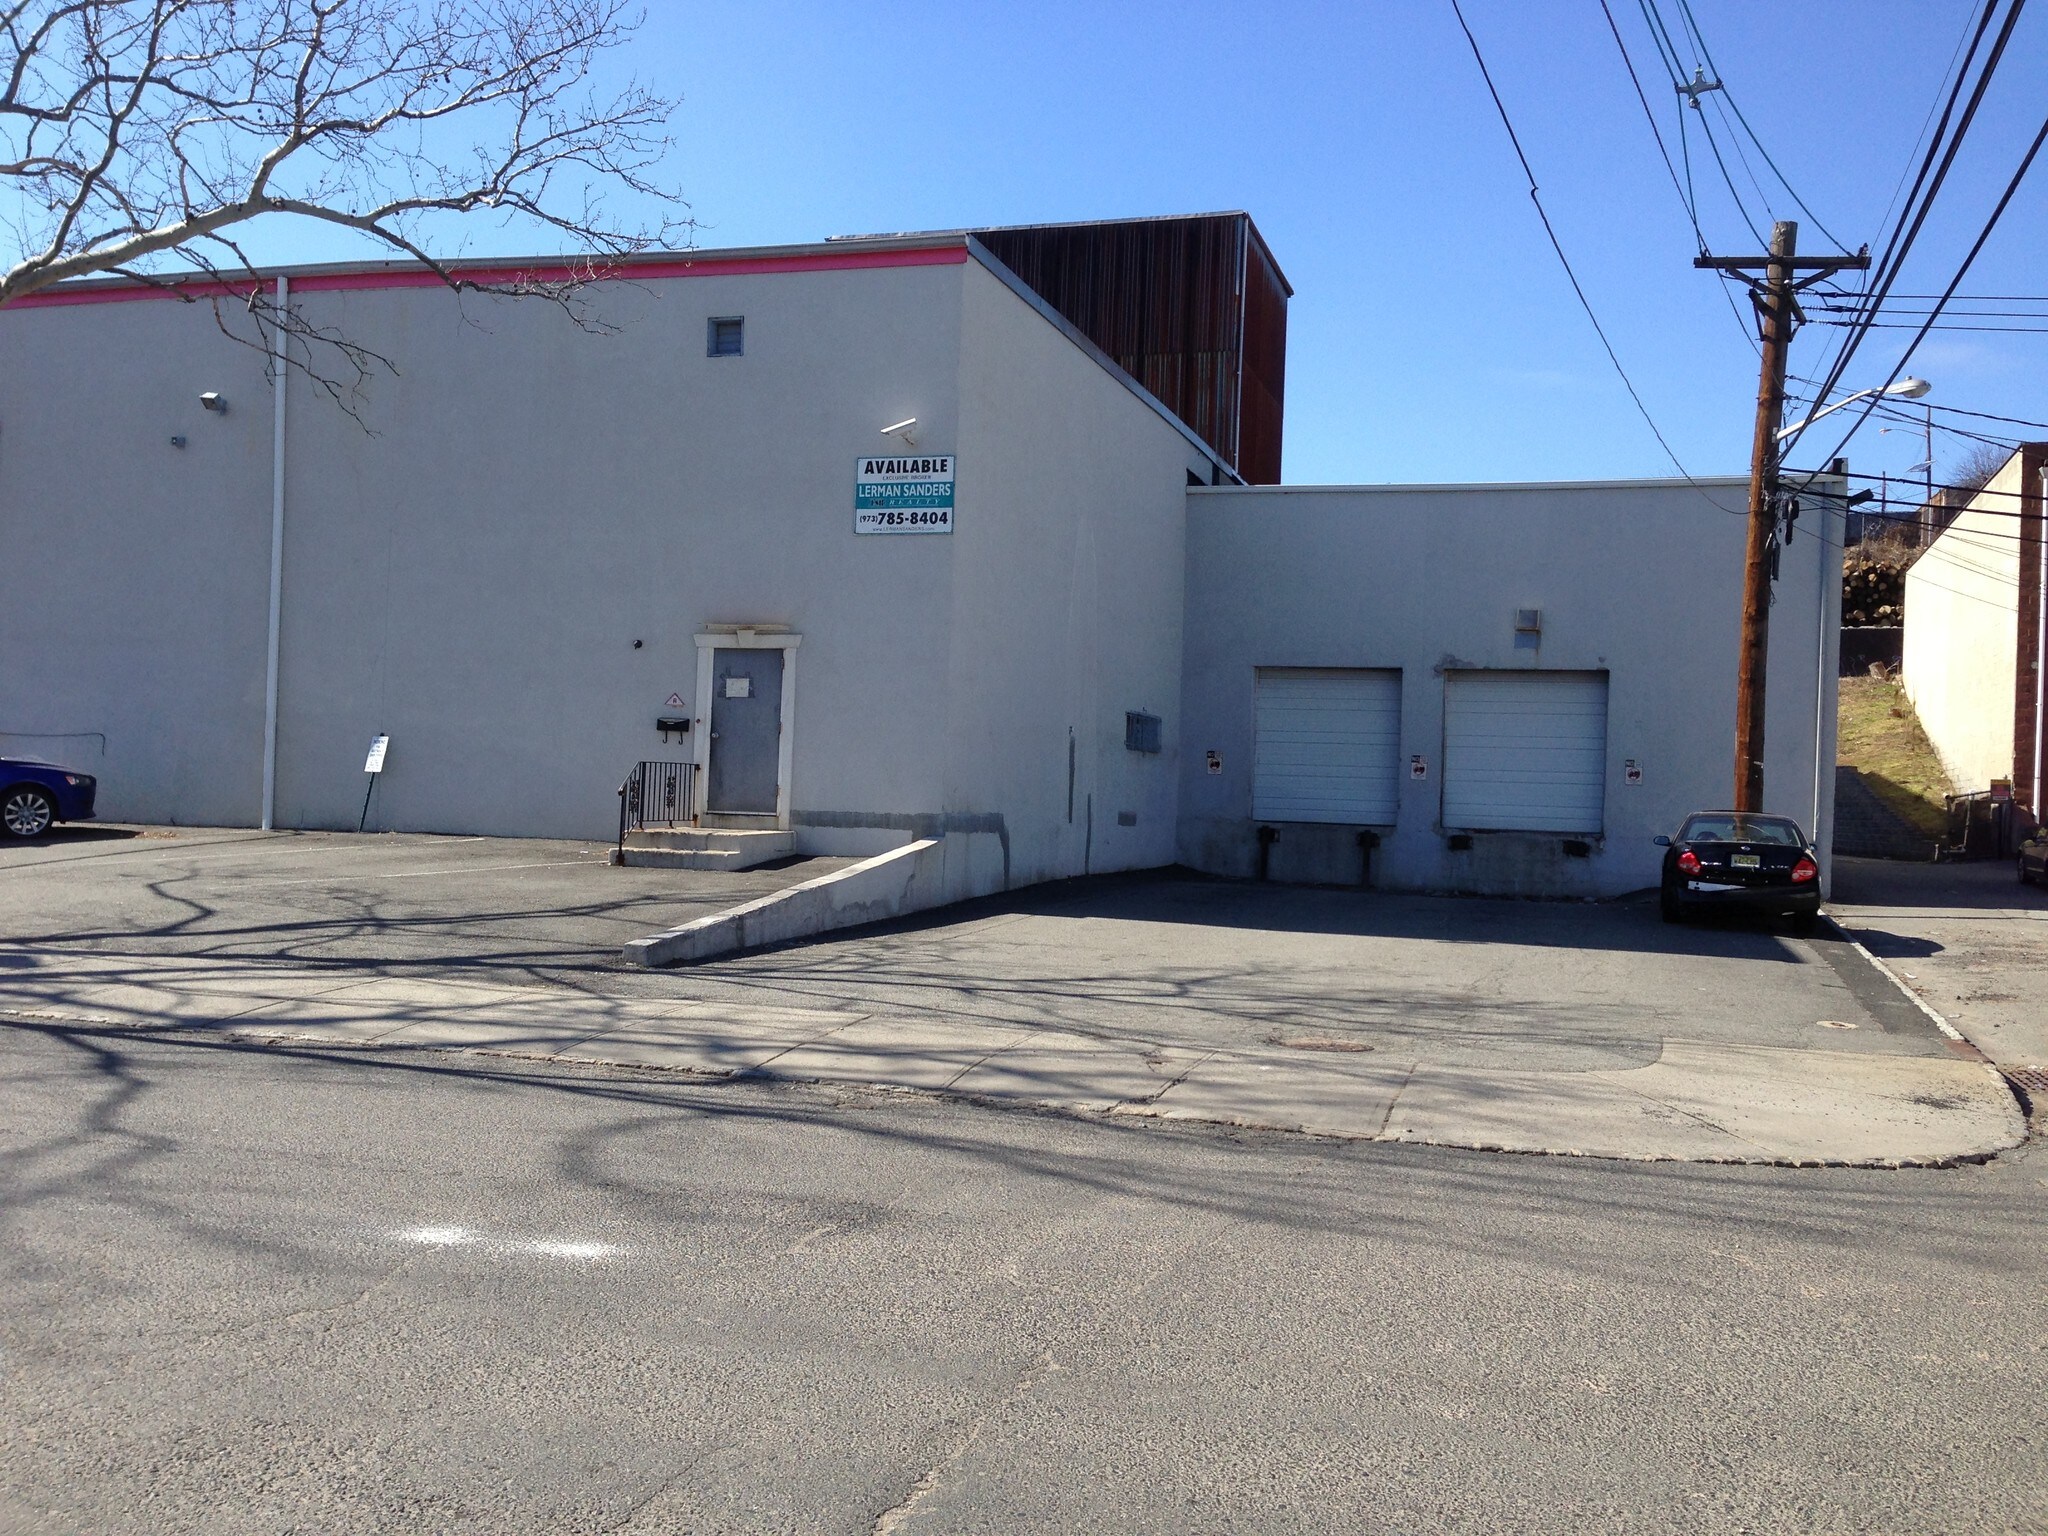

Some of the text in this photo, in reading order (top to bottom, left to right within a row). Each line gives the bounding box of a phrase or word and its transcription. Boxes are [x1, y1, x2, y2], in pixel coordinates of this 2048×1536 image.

[864, 459, 948, 474] AVAILABLE
[858, 483, 951, 498] LERMAN SANDERS
[878, 511, 948, 525] 785-8404
